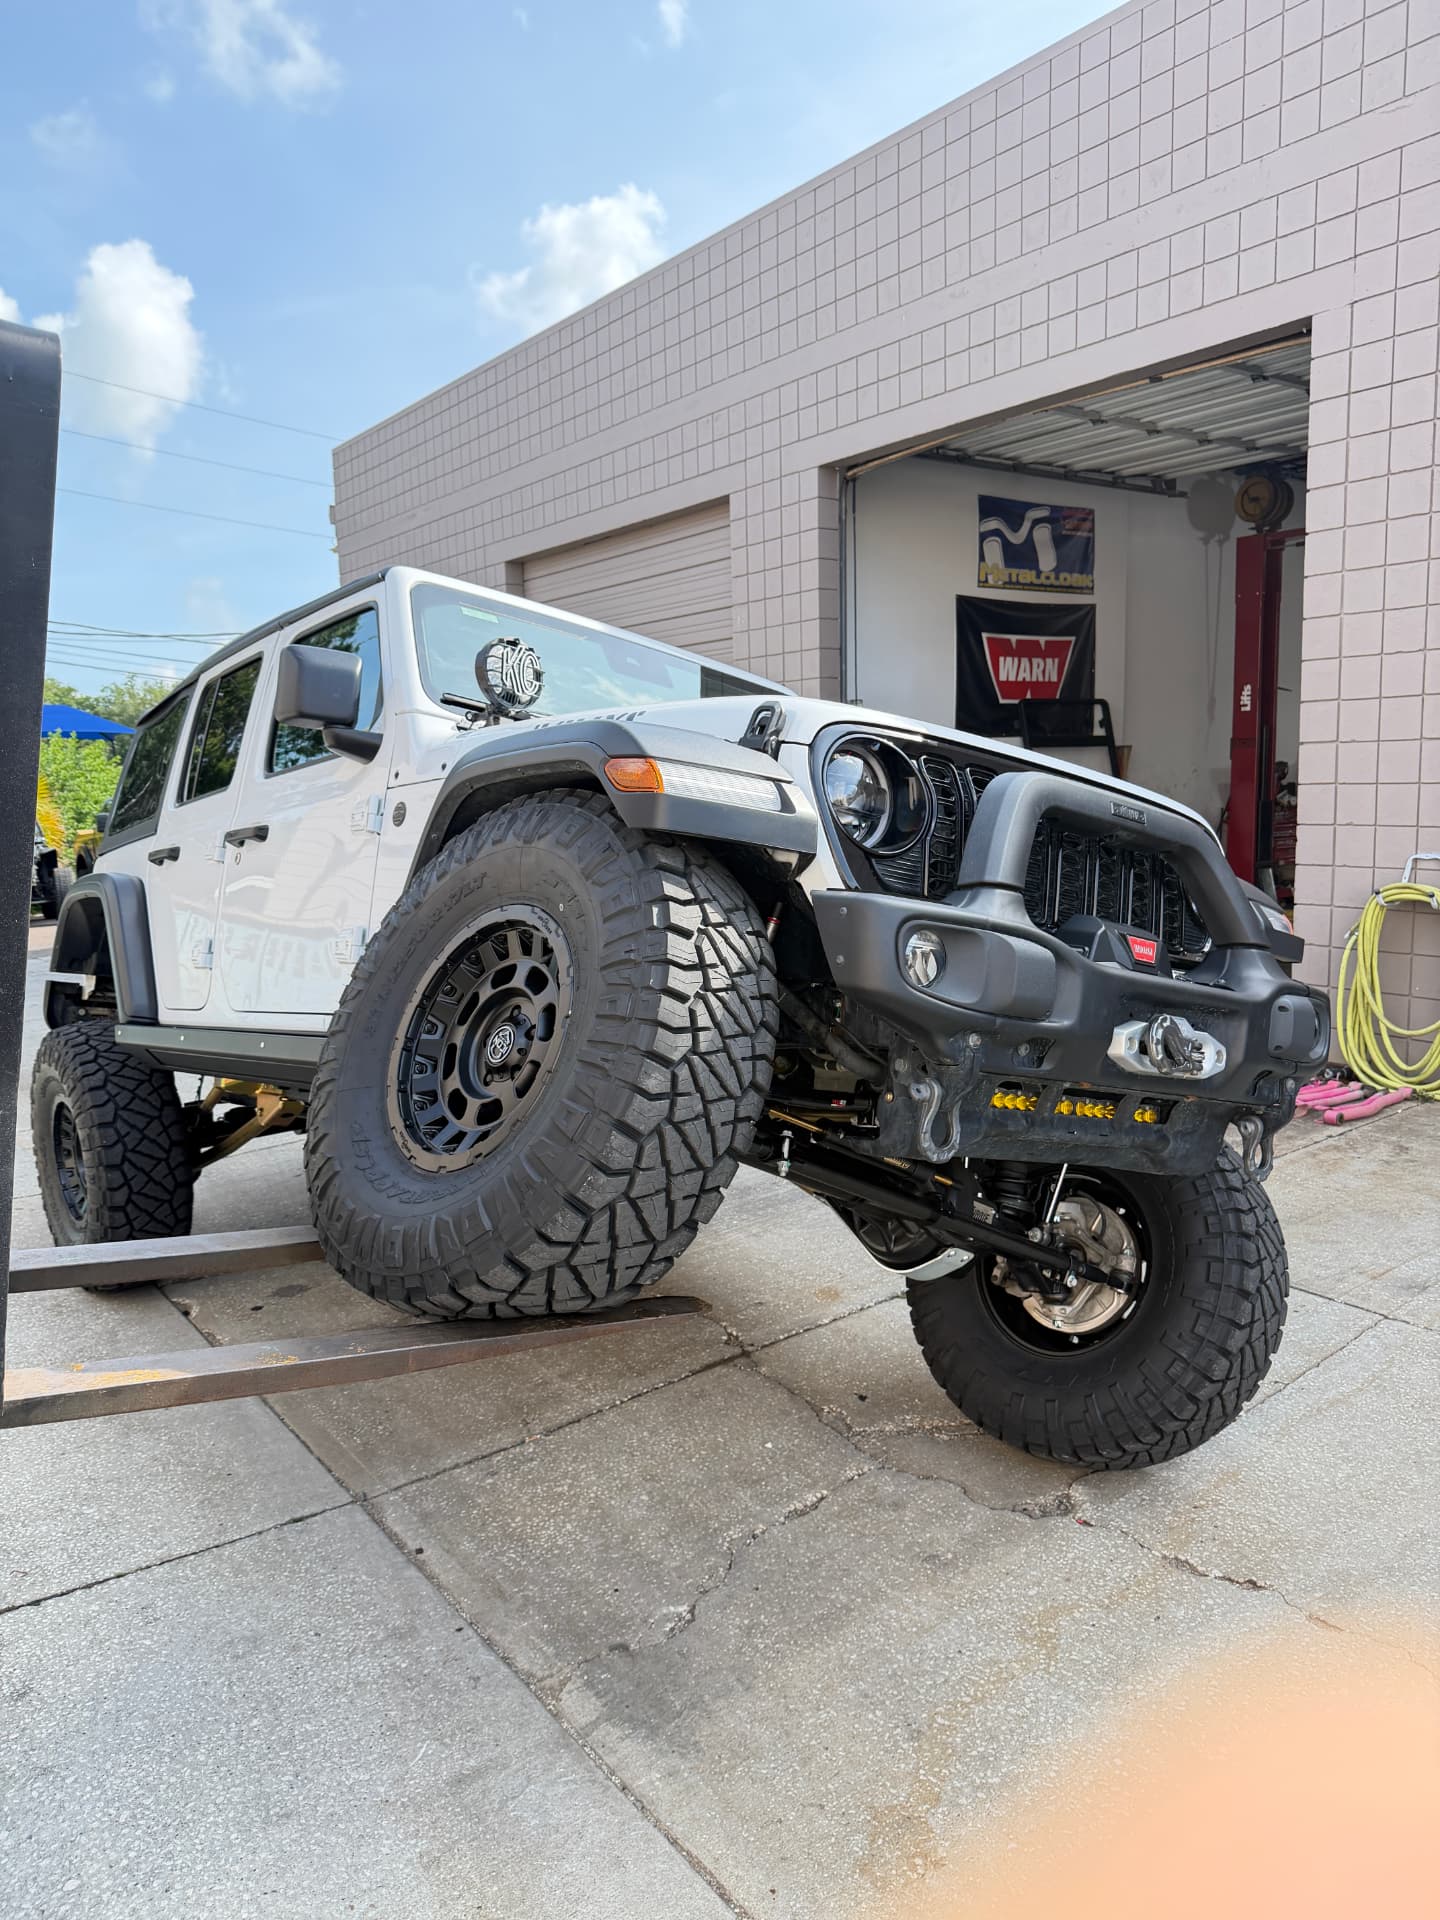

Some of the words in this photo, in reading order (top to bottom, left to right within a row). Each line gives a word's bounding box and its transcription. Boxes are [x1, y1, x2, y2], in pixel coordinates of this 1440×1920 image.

[502, 644, 541, 696] KC
[999, 656, 1059, 683] WARN
[1240, 684, 1251, 711] Lifts
